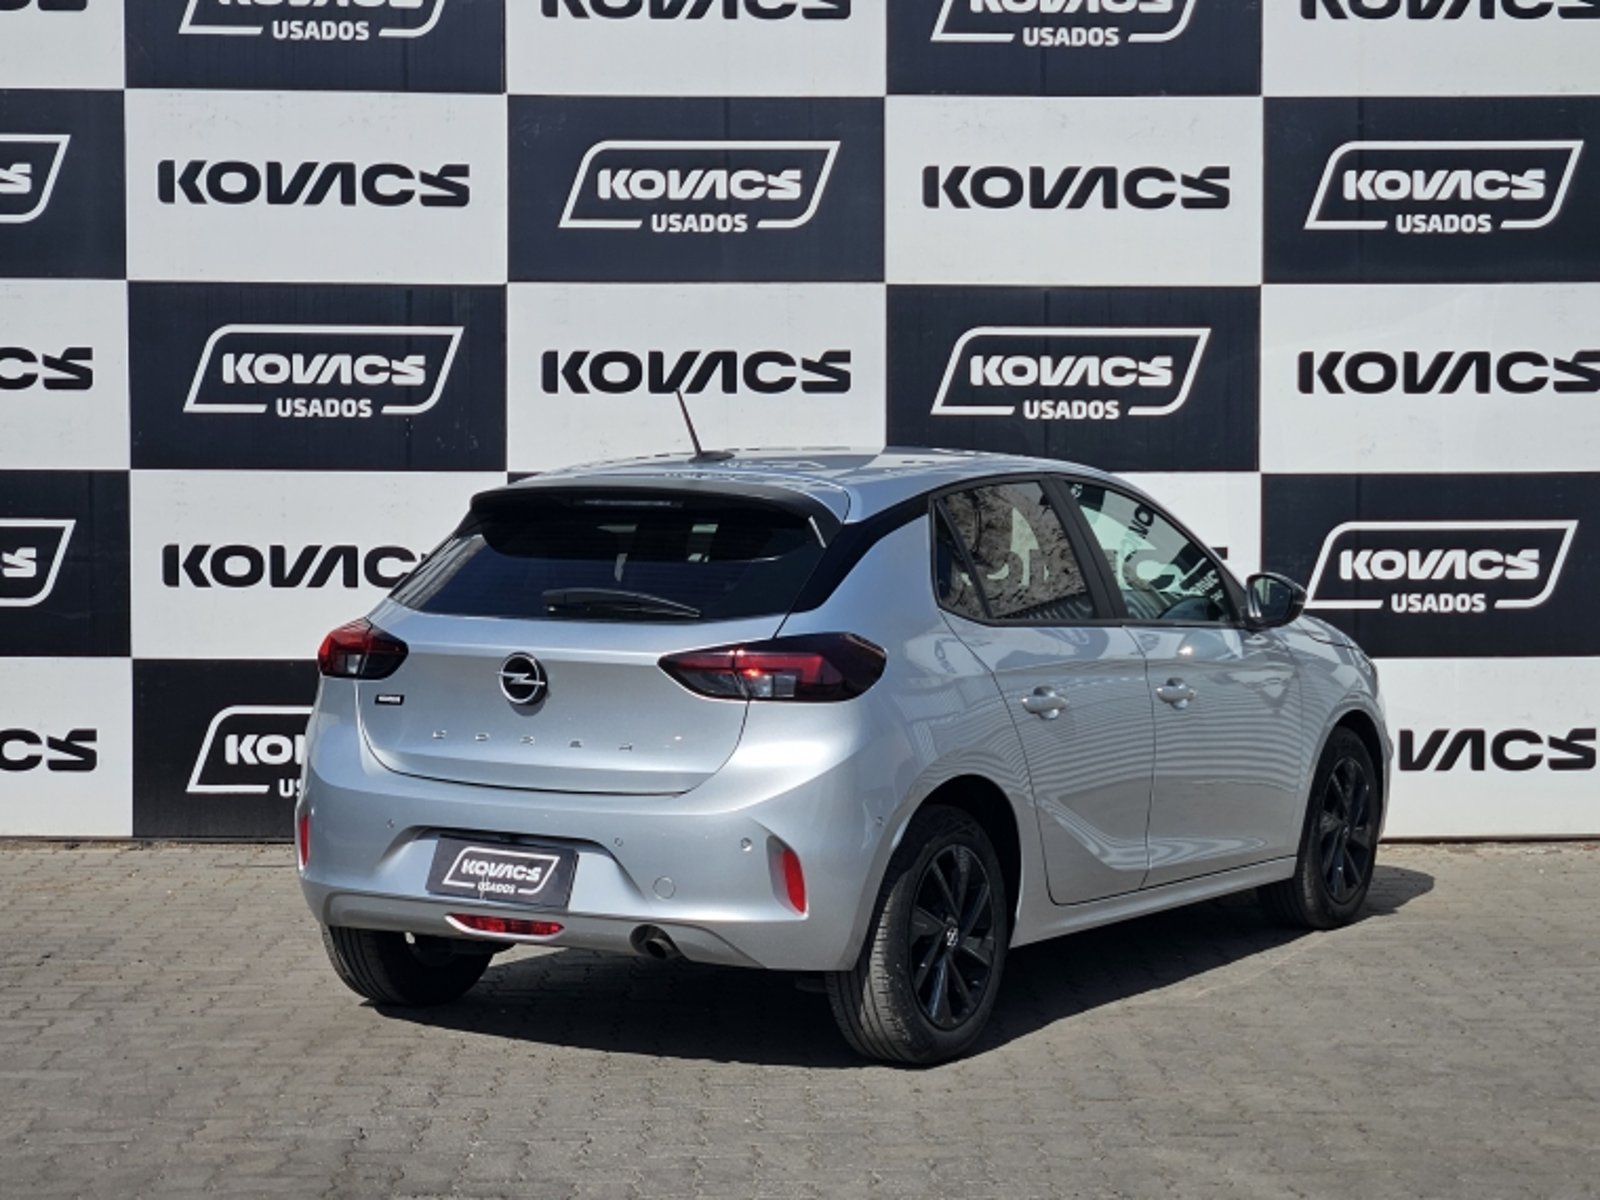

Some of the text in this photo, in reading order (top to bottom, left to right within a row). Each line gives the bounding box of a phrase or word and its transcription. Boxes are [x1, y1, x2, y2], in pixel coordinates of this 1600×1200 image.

[272, 20, 370, 41] USADOS
[1022, 26, 1120, 47] USADOS
[157, 159, 470, 207] KOVACS
[597, 169, 802, 200] KOVACS
[922, 165, 1230, 210] KOVACS
[1343, 169, 1546, 201] KOVACS
[651, 213, 748, 233] USADOS
[1395, 214, 1492, 234] USADOS
[222, 353, 426, 386] KOVACS
[541, 350, 851, 394] KOVACS
[970, 355, 1173, 387] KOVACS
[1298, 350, 1600, 394] KOVACS
[276, 398, 373, 418] USADOS
[1023, 399, 1120, 420] USADOS
[162, 544, 428, 588] KOVAC
[1339, 549, 1540, 581] KOVACS
[1391, 593, 1487, 613] USADOS
[461, 858, 542, 882] KOVACS
